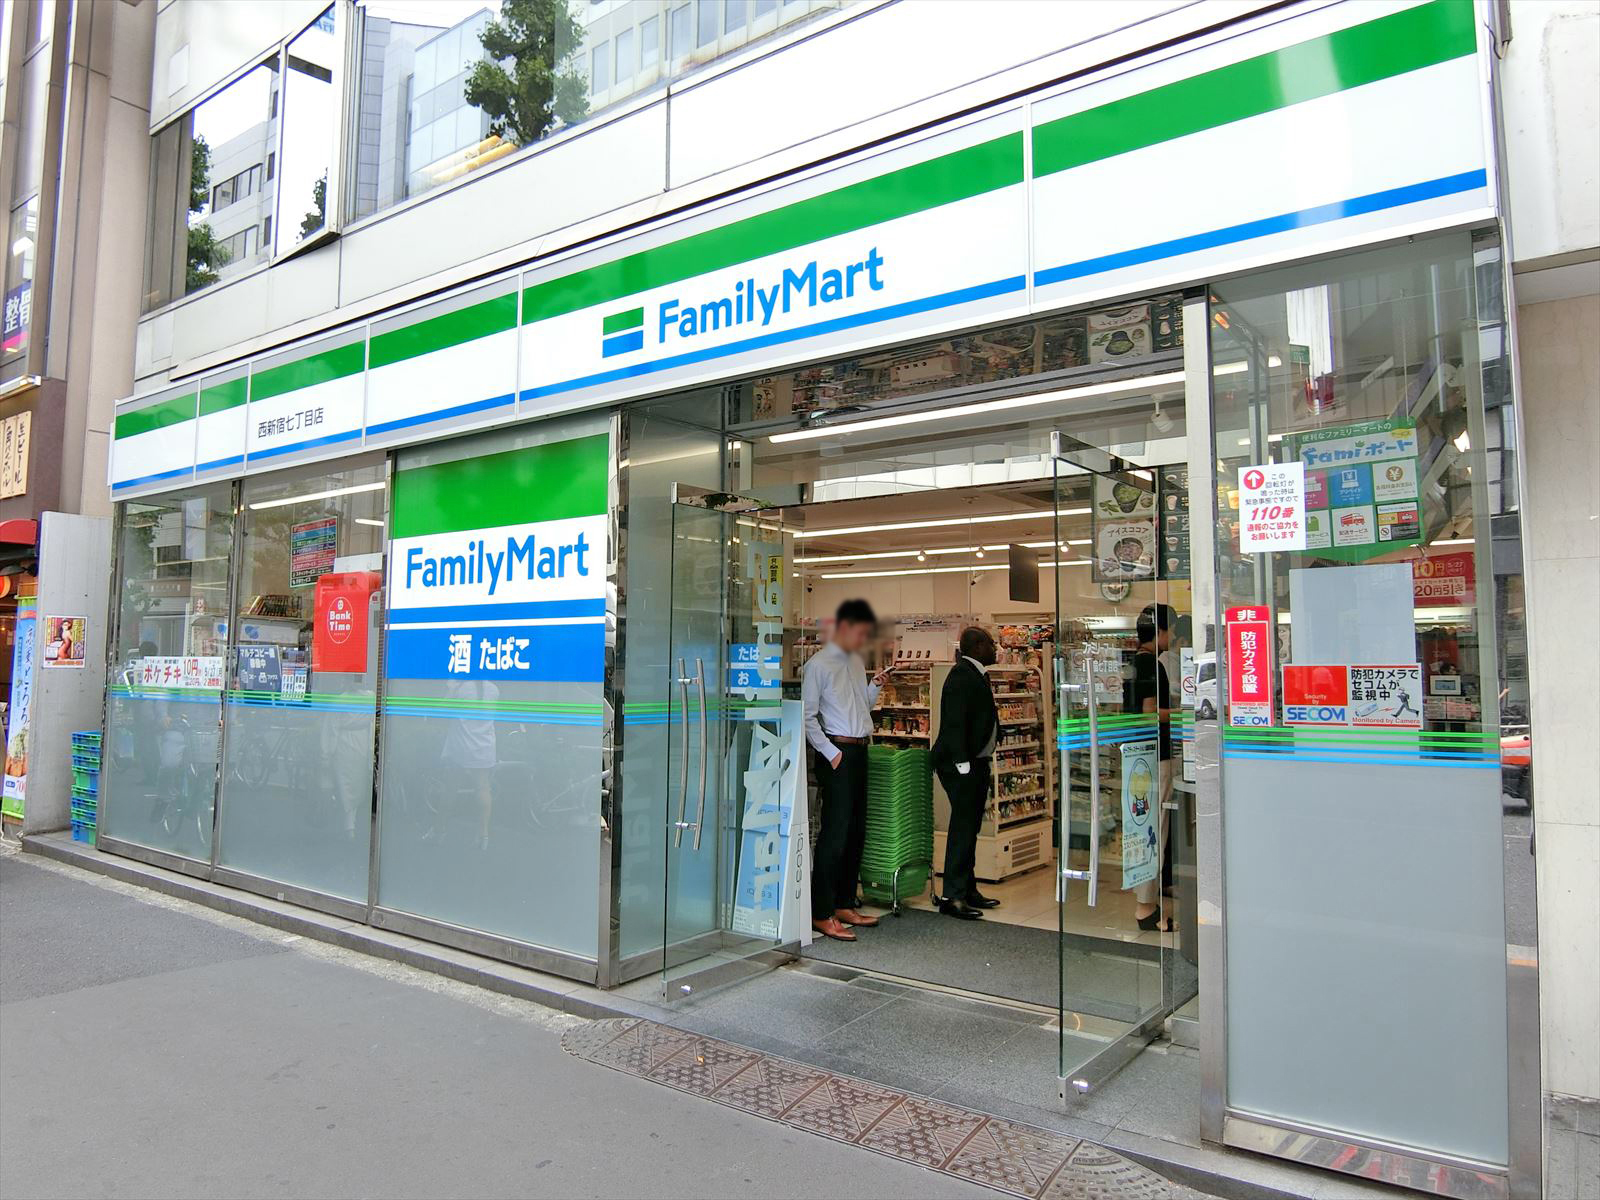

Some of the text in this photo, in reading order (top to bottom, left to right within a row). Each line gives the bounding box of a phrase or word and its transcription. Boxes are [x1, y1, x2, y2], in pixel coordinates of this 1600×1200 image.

[658, 247, 884, 344] FamilyMart
[257, 407, 325, 439] 西新宿七丁目店
[1302, 422, 1392, 442] 便利なファミリーマートの
[1302, 439, 1413, 465] Famiポート
[1251, 505, 1295, 521] 110番
[1107, 526, 1149, 537] アイスココア
[1247, 521, 1299, 532] 通報のご協力を
[1251, 531, 1296, 541] お願いします
[406, 531, 590, 595] FamilyMart
[1414, 584, 1464, 596] 20円引き
[329, 611, 351, 620] Bank
[329, 622, 351, 631] Time
[448, 634, 530, 673] 酒 たばこ
[1240, 631, 1258, 694] 防犯カメラ設置
[144, 664, 181, 684] ポケチキ
[1351, 669, 1419, 680] 防犯カメラで
[1351, 679, 1400, 690] セコムが
[1351, 690, 1391, 701] 監視中
[1233, 716, 1269, 725] SECOM
[1287, 707, 1345, 721] SECOM
